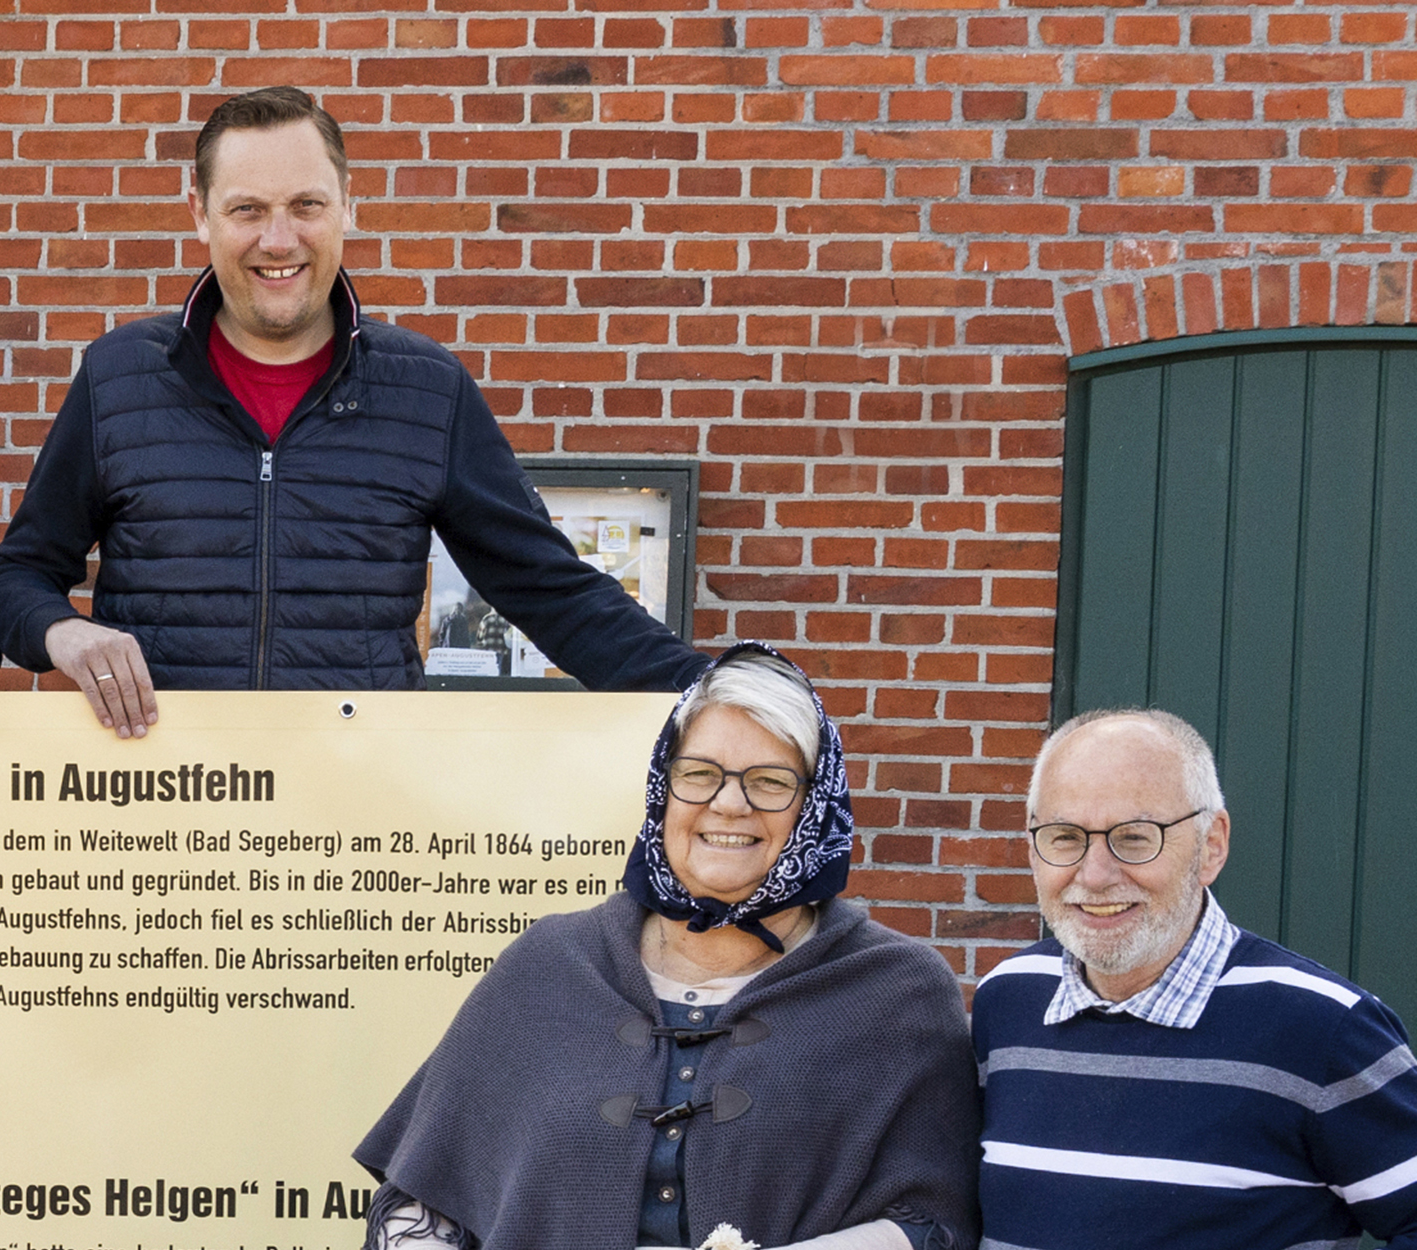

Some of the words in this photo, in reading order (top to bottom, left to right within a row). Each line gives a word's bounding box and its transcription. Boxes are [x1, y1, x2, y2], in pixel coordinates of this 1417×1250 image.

[11, 762, 45, 802] in
[58, 762, 275, 807] Augustfehn
[3, 828, 46, 851] dem
[54, 829, 72, 852] in
[79, 829, 178, 852] Weitewelt
[185, 829, 230, 854] (Bad
[238, 829, 342, 858] Segeberg)
[350, 836, 382, 853] am
[389, 831, 420, 854] 28.
[427, 832, 477, 861] April
[484, 832, 533, 856] 1864
[541, 833, 626, 862] geboren
[11, 868, 80, 896] gebaut
[87, 868, 124, 891] und
[132, 869, 241, 897] gegründet.
[249, 869, 280, 892] Bis
[287, 874, 305, 891] in
[313, 869, 344, 892] die
[497, 877, 538, 896] war
[543, 878, 569, 896] es
[575, 872, 608, 896] ein
[134, 907, 202, 936] jedoch
[210, 908, 244, 931] fiel
[250, 914, 274, 931] es
[282, 908, 393, 932] schließlich
[401, 910, 436, 932] der
[88, 952, 111, 969] zu
[117, 946, 209, 970] schaffen.
[215, 947, 246, 970] Die
[251, 947, 399, 971] Abrissarbeiten
[125, 985, 219, 1015] endgültig
[225, 986, 355, 1010] verschwand.
[274, 1180, 310, 1219] in
